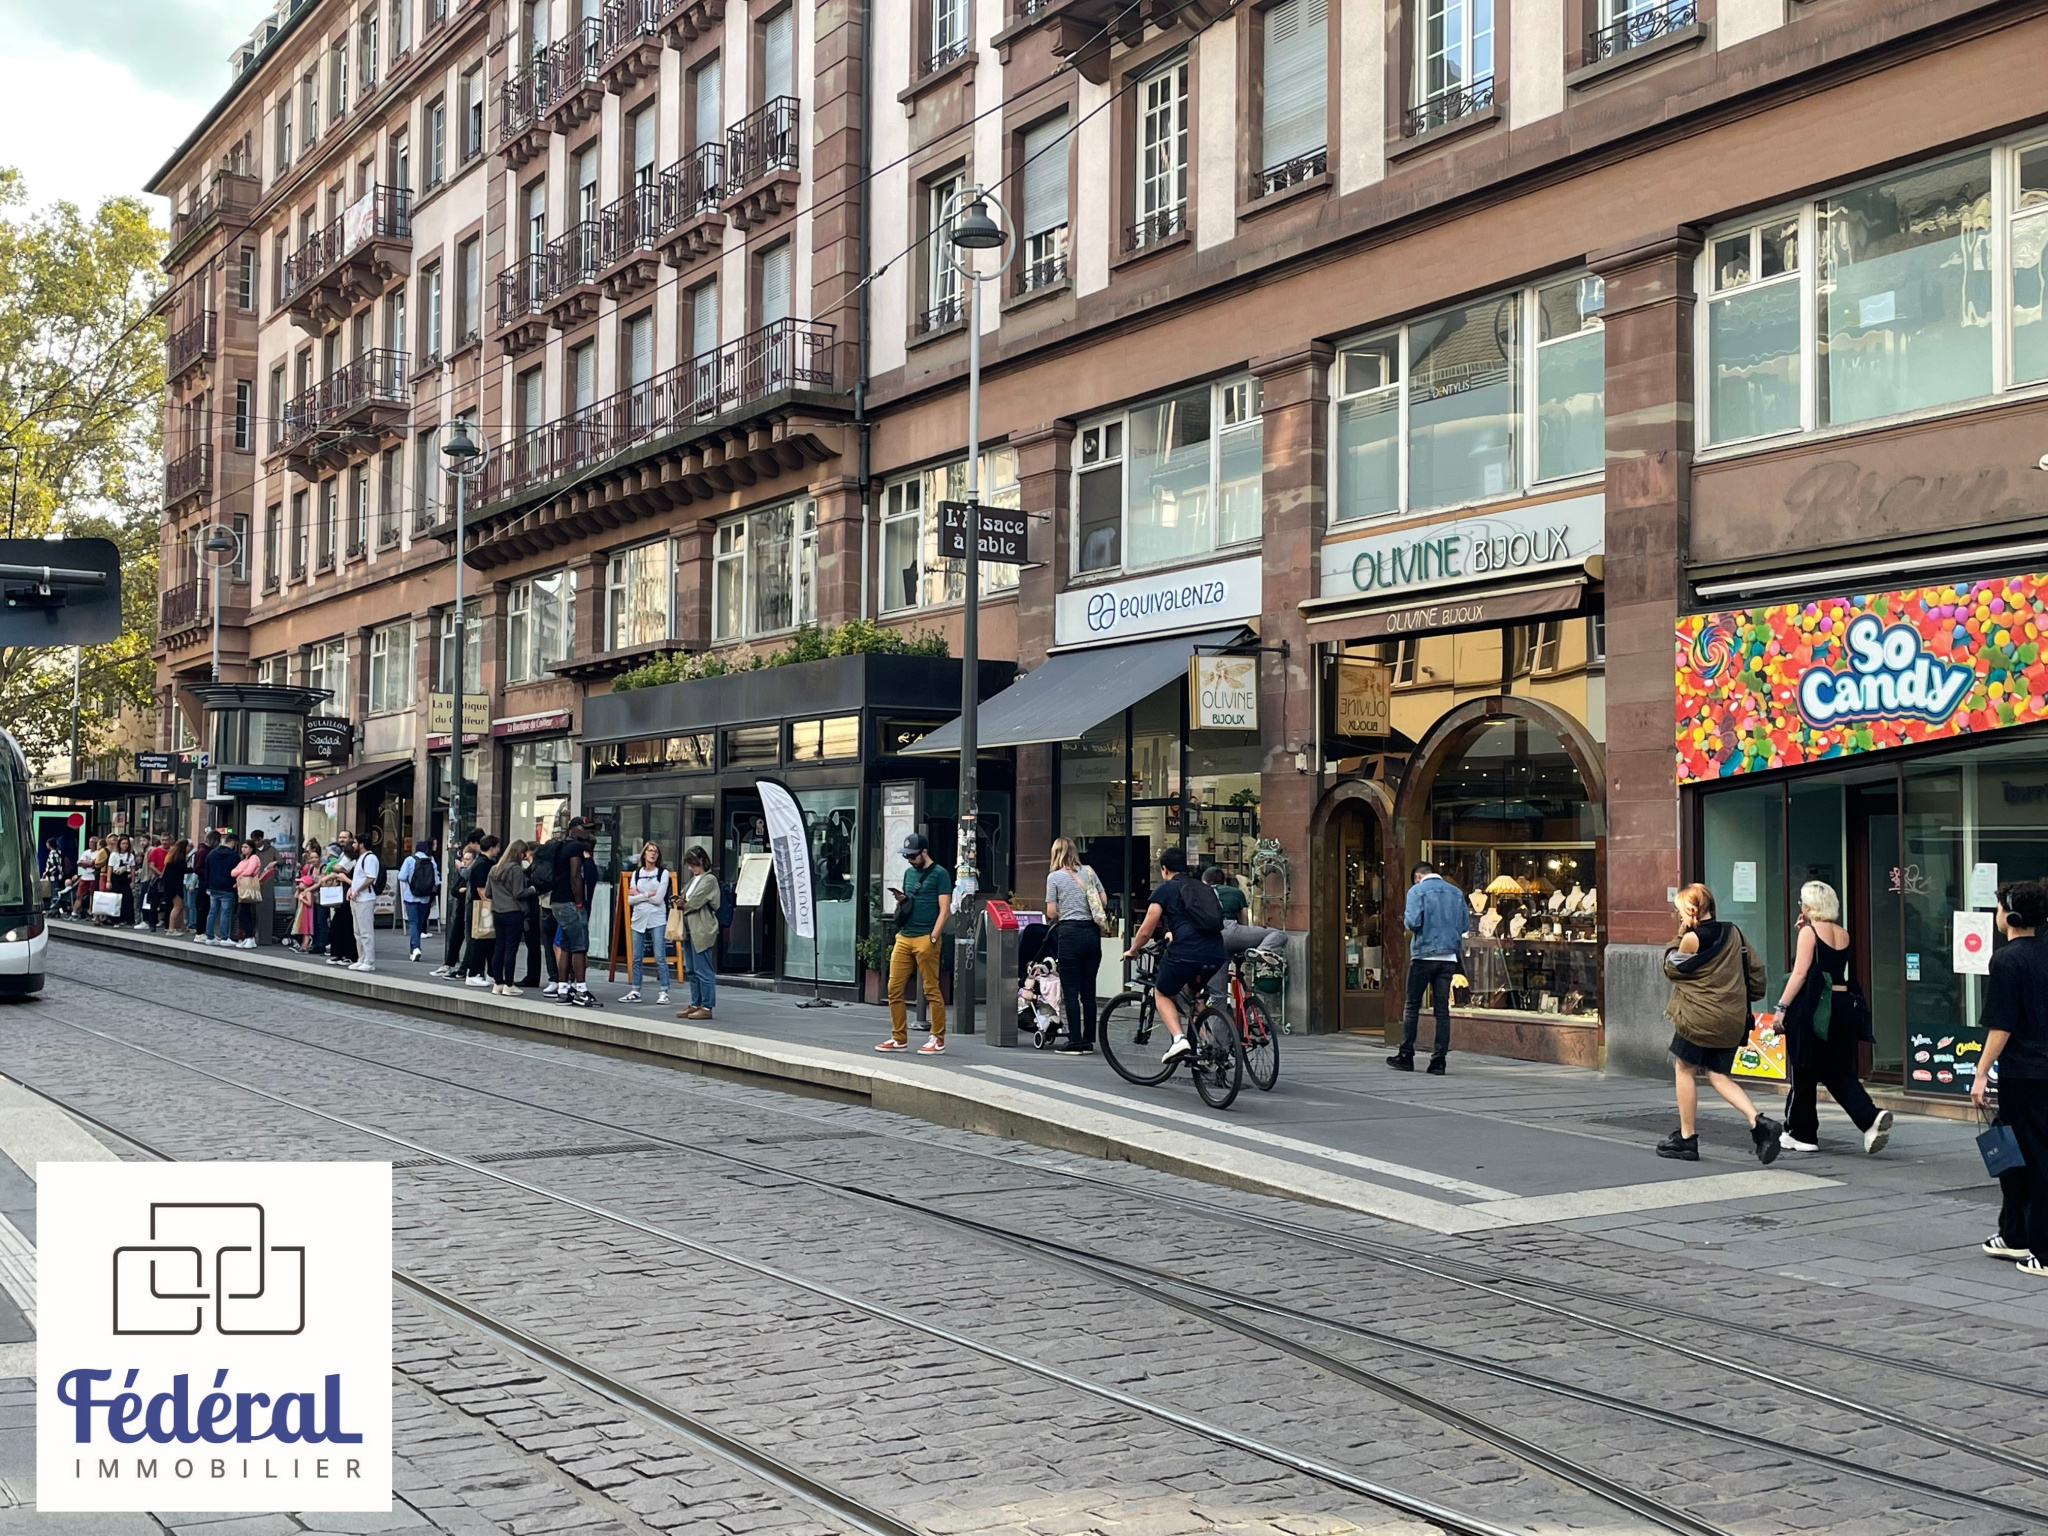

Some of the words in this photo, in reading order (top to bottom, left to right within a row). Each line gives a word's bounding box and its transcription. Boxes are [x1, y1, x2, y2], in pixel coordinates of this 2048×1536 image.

[953, 533, 964, 550] à
[978, 536, 1016, 555] able
[1352, 536, 1461, 591] OLIVINE
[1473, 525, 1569, 572] BIJOUX
[1387, 608, 1438, 632] OLIVINE
[1442, 605, 1484, 625] BIJOUX
[1802, 657, 1967, 720] Candy
[432, 699, 443, 709] La
[446, 700, 488, 711] Btique
[1202, 691, 1254, 709] OLIVINE
[435, 715, 446, 724] du
[1213, 714, 1245, 725] BIJOUX
[790, 824, 809, 925] EQUIVALENZA
